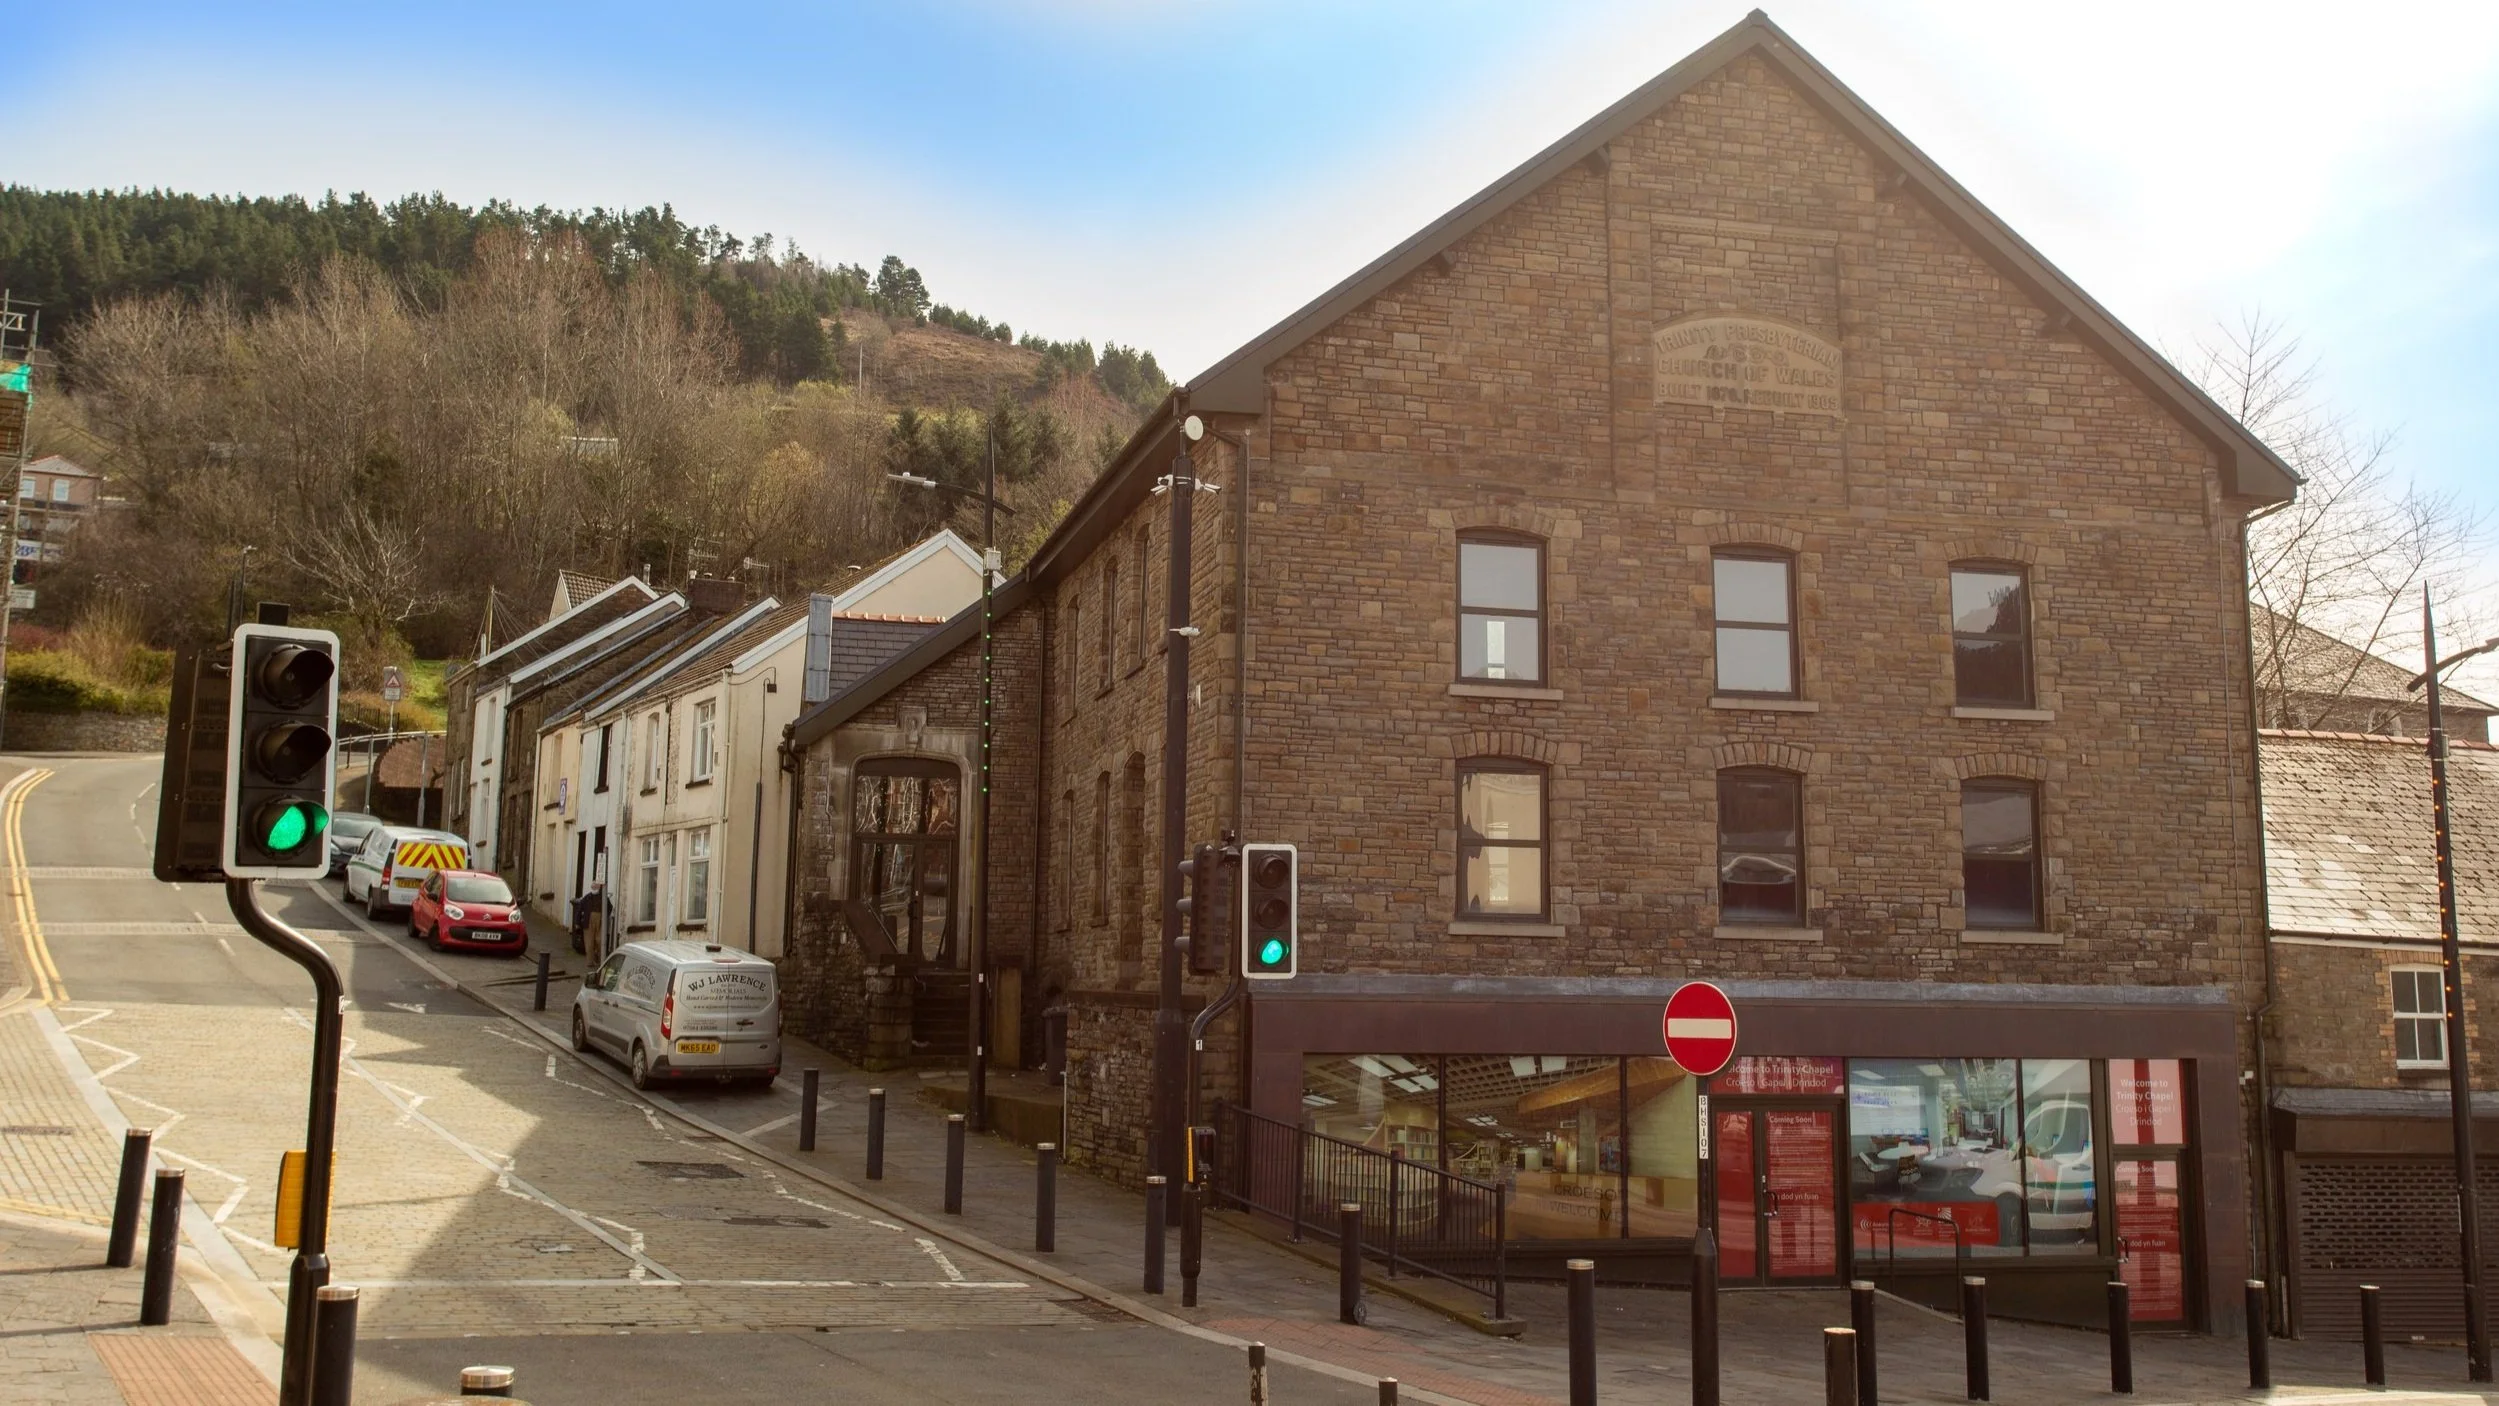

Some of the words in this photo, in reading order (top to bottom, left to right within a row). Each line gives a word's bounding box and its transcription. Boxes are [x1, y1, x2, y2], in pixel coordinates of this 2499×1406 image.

[1655, 325, 1716, 354] TRINITY
[1725, 324, 1841, 370] PRESBYTERIAN
[1657, 358, 1738, 381] CHURCH
[1743, 366, 1769, 383] OF
[1776, 367, 1837, 389] WALES
[1658, 382, 1702, 399] BUILT
[1743, 388, 1805, 409] REBUILT
[688, 979, 705, 992] WJ
[708, 973, 767, 992] LAWRENCE
[1728, 1064, 1760, 1074] lcome
[1761, 1065, 1771, 1074] to
[1772, 1064, 1800, 1075] Trinity
[1802, 1064, 1834, 1077] Chapel
[1725, 1078, 1755, 1087] Croeso
[1793, 1078, 1827, 1087] Drindod
[2120, 1079, 2159, 1088] Welcome
[2160, 1080, 2168, 1088] to
[2117, 1091, 2143, 1103] Trinity
[2144, 1091, 2174, 1103] Chapel
[2116, 1104, 2143, 1113] Croeso
[1769, 1116, 1794, 1125] Coming
[2129, 1117, 2162, 1127] Drindod
[1554, 1184, 1617, 1201] CROESO
[1781, 1192, 1794, 1200] dod
[1795, 1194, 1803, 1202] yn
[1804, 1192, 1819, 1200] fuan
